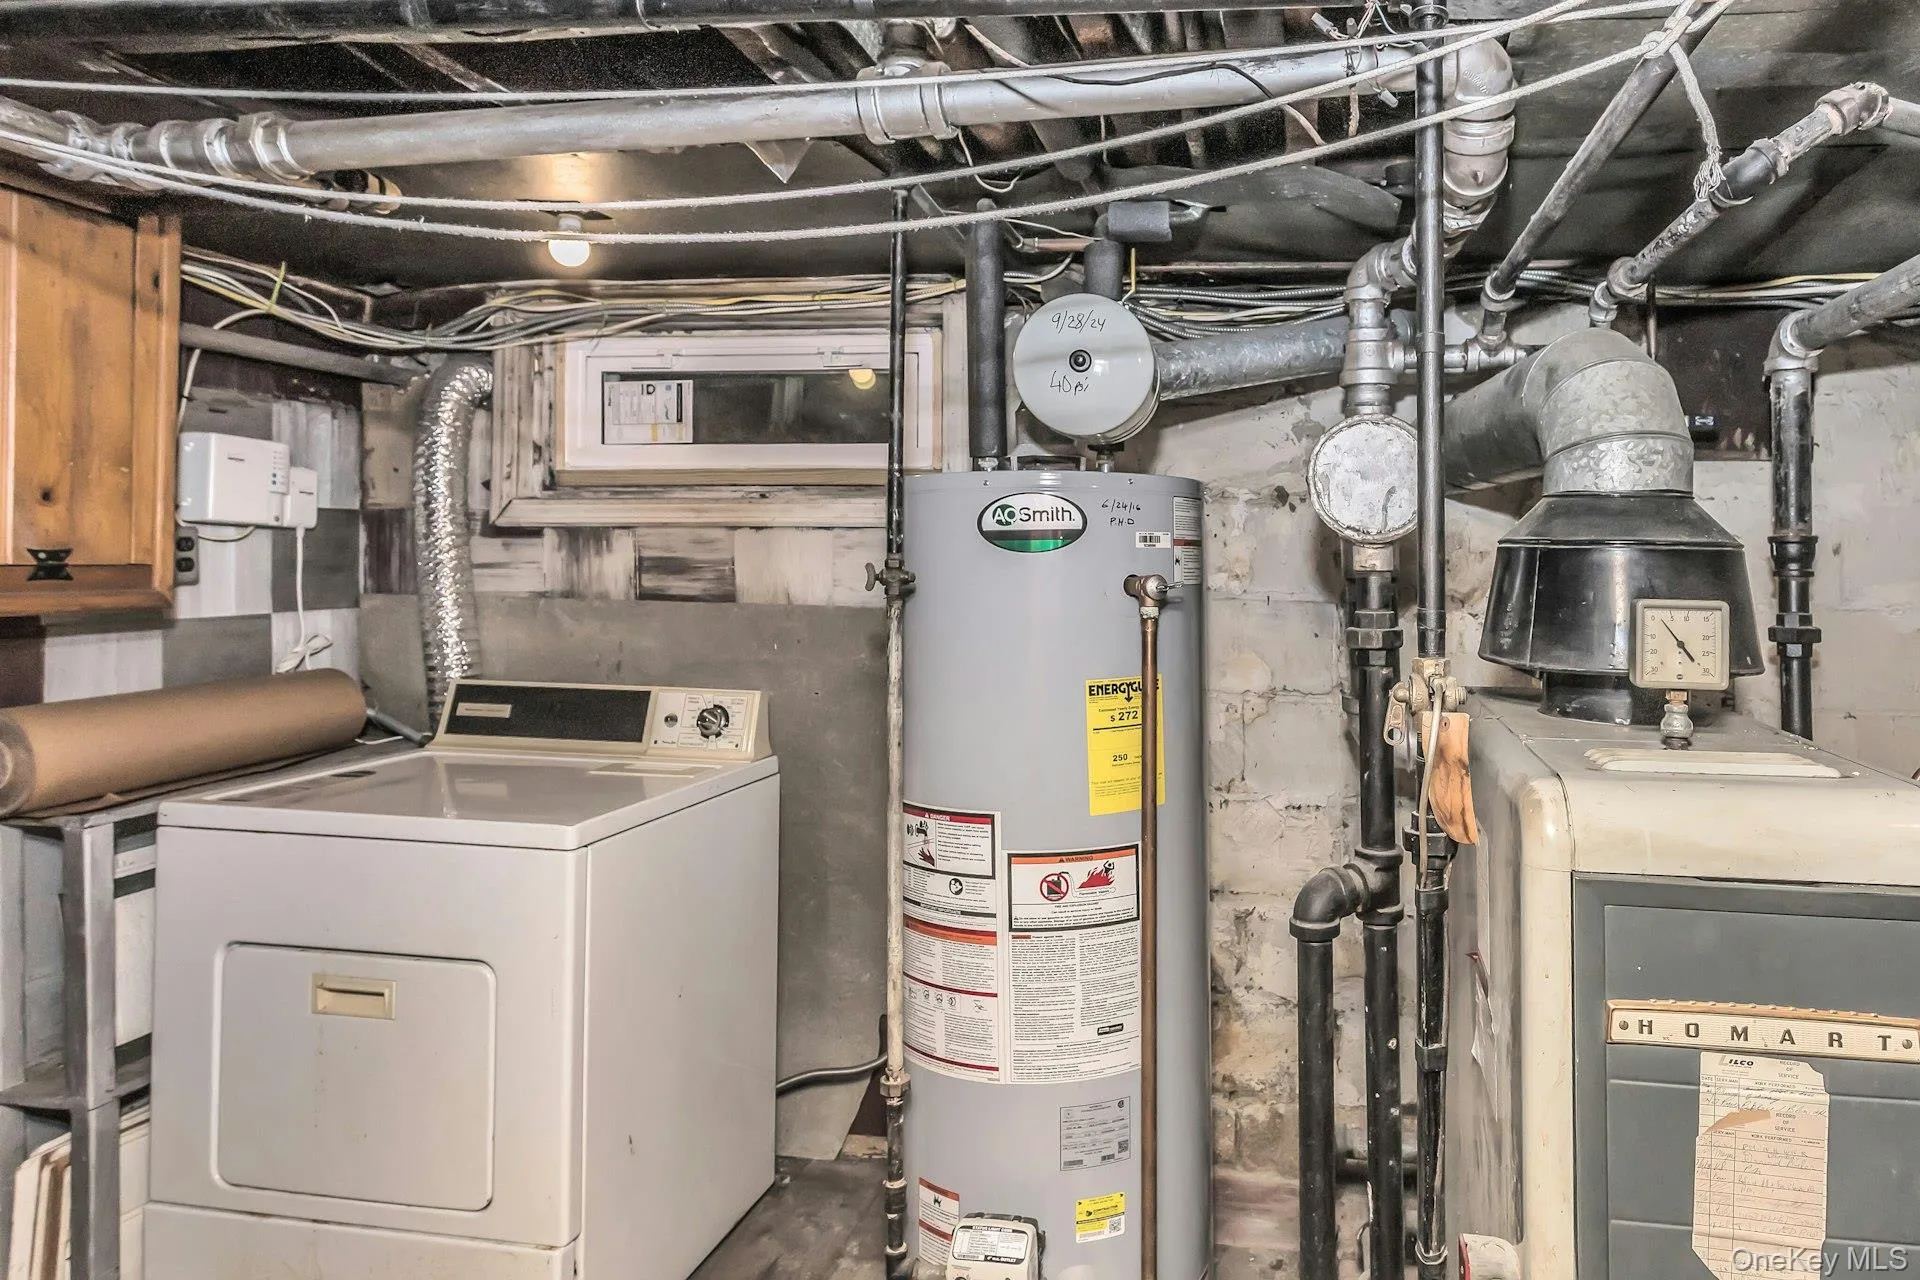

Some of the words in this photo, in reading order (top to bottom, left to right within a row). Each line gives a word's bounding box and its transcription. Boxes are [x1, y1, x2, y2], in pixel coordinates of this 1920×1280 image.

[1051, 309, 1106, 334] 9/28/24
[1101, 498, 1141, 514] 6/24/16
[1118, 710, 1139, 721] 272
[1112, 753, 1128, 762] 250
[930, 813, 950, 822] DANGER
[1065, 855, 1094, 863] WARNING
[1637, 1019, 1893, 1051] HOMART
[1775, 1112, 1797, 1120] RECORD
